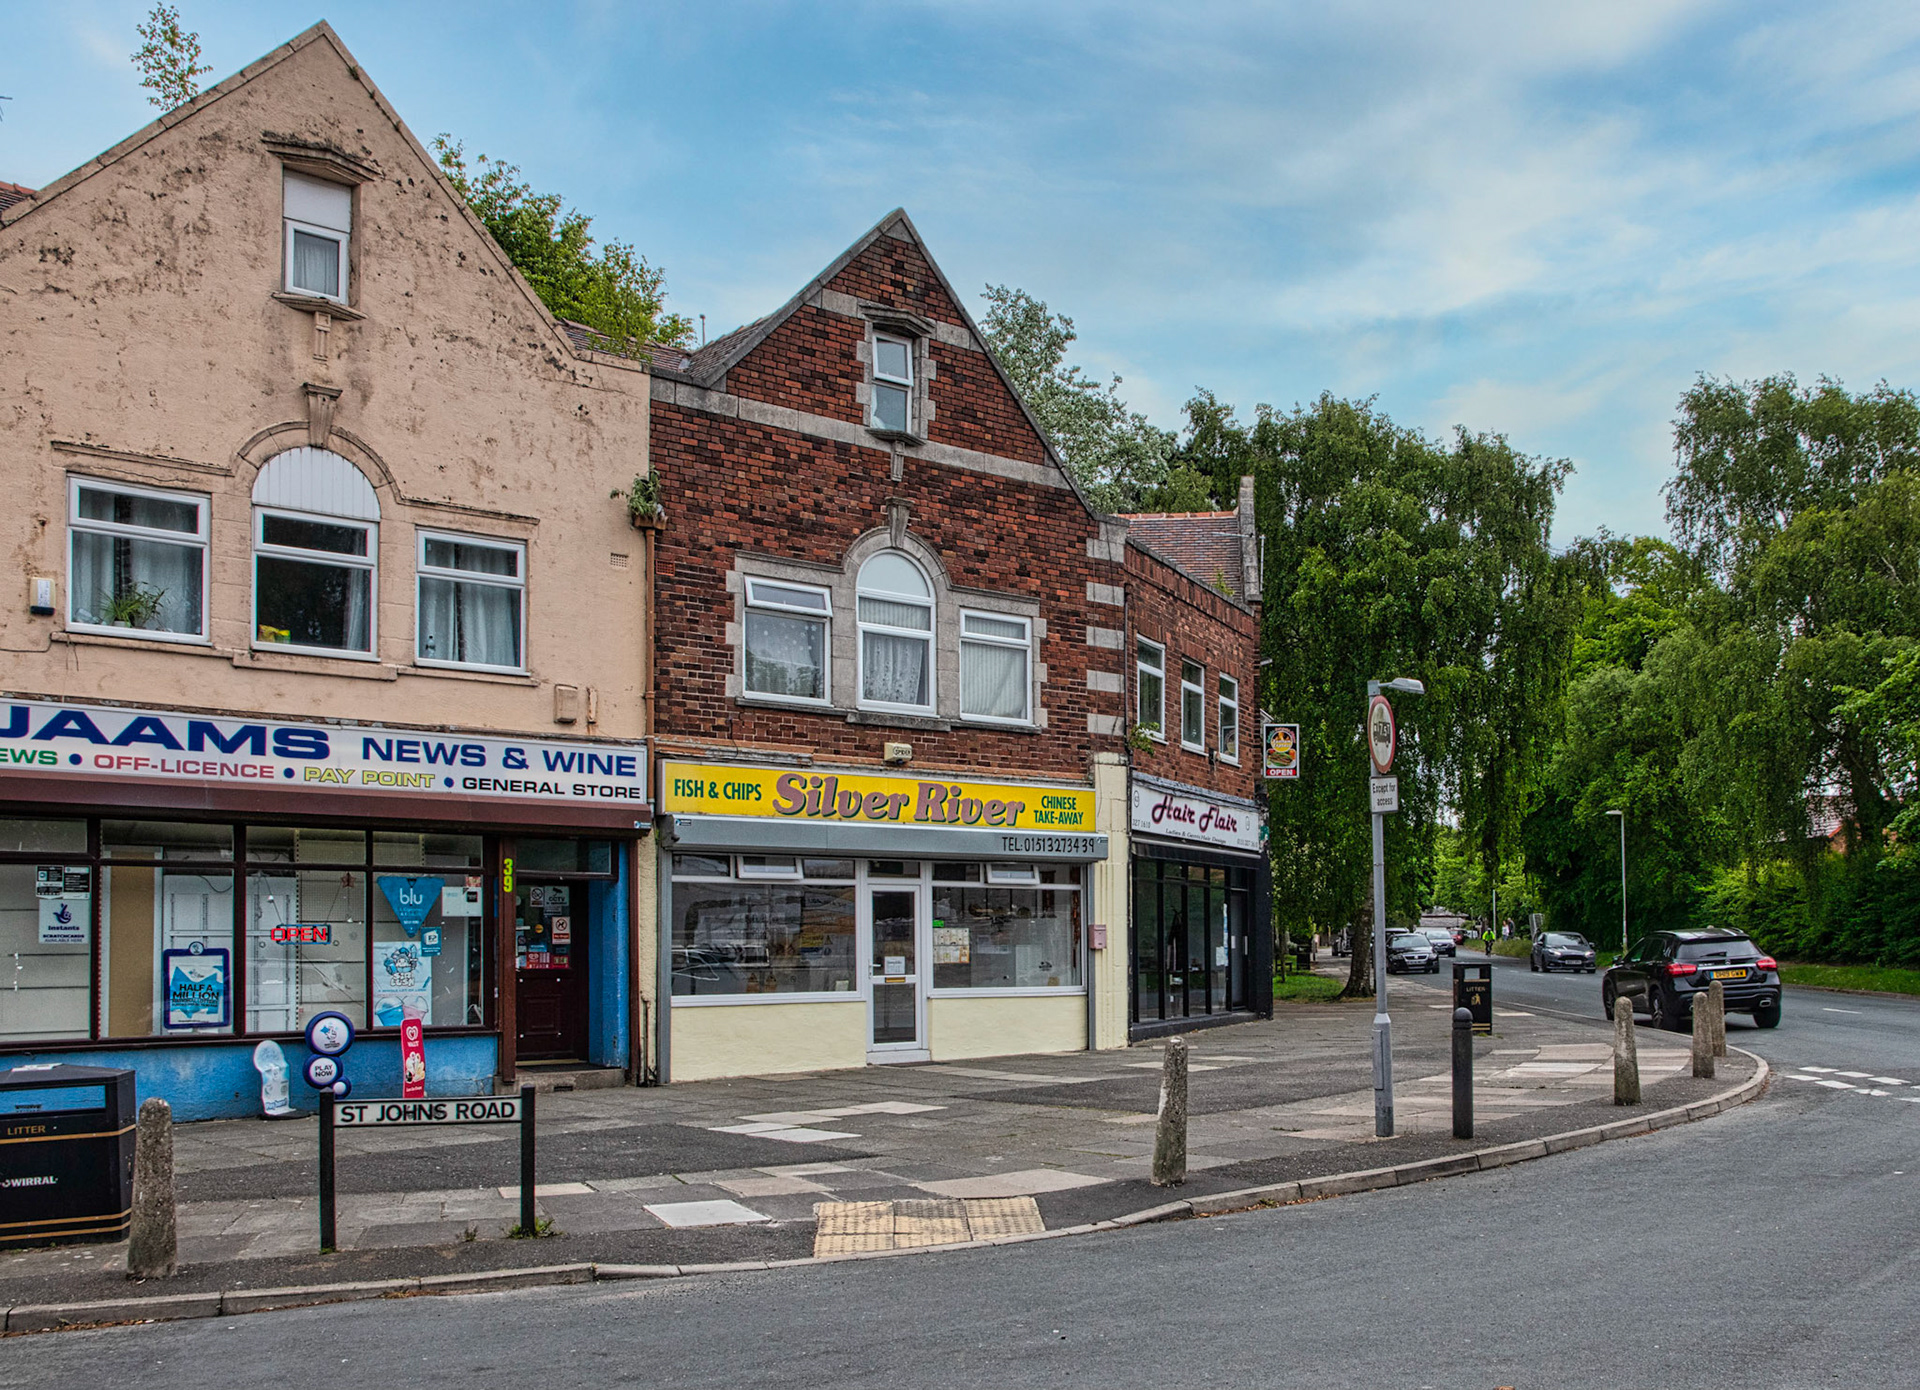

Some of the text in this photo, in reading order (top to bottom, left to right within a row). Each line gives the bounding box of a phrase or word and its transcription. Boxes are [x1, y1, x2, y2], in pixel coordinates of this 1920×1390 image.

[0, 705, 637, 777] JAAMS NEWS & WINE
[94, 754, 275, 779] OFF-LICENCE
[304, 766, 356, 784] PAY
[362, 770, 435, 788] POINT
[462, 777, 566, 795] GENERAL
[572, 784, 641, 799] STORE
[674, 779, 762, 801] FISH & CHIPS
[1372, 784, 1388, 794] Except
[772, 773, 1026, 827] Silver River
[1041, 795, 1077, 810] CHINESE
[1377, 798, 1393, 806] access
[1034, 810, 1084, 825] TAKE-AWAY
[1151, 795, 1238, 833] Hair Flair
[503, 858, 514, 893] 39
[400, 887, 423, 905] blu
[270, 927, 328, 942] OPEN
[172, 991, 220, 1001] MILLION
[341, 1102, 515, 1122] ST JOHNS ROAD
[7, 1125, 46, 1135] LITTER
[11, 1175, 57, 1187] WIRRAL
